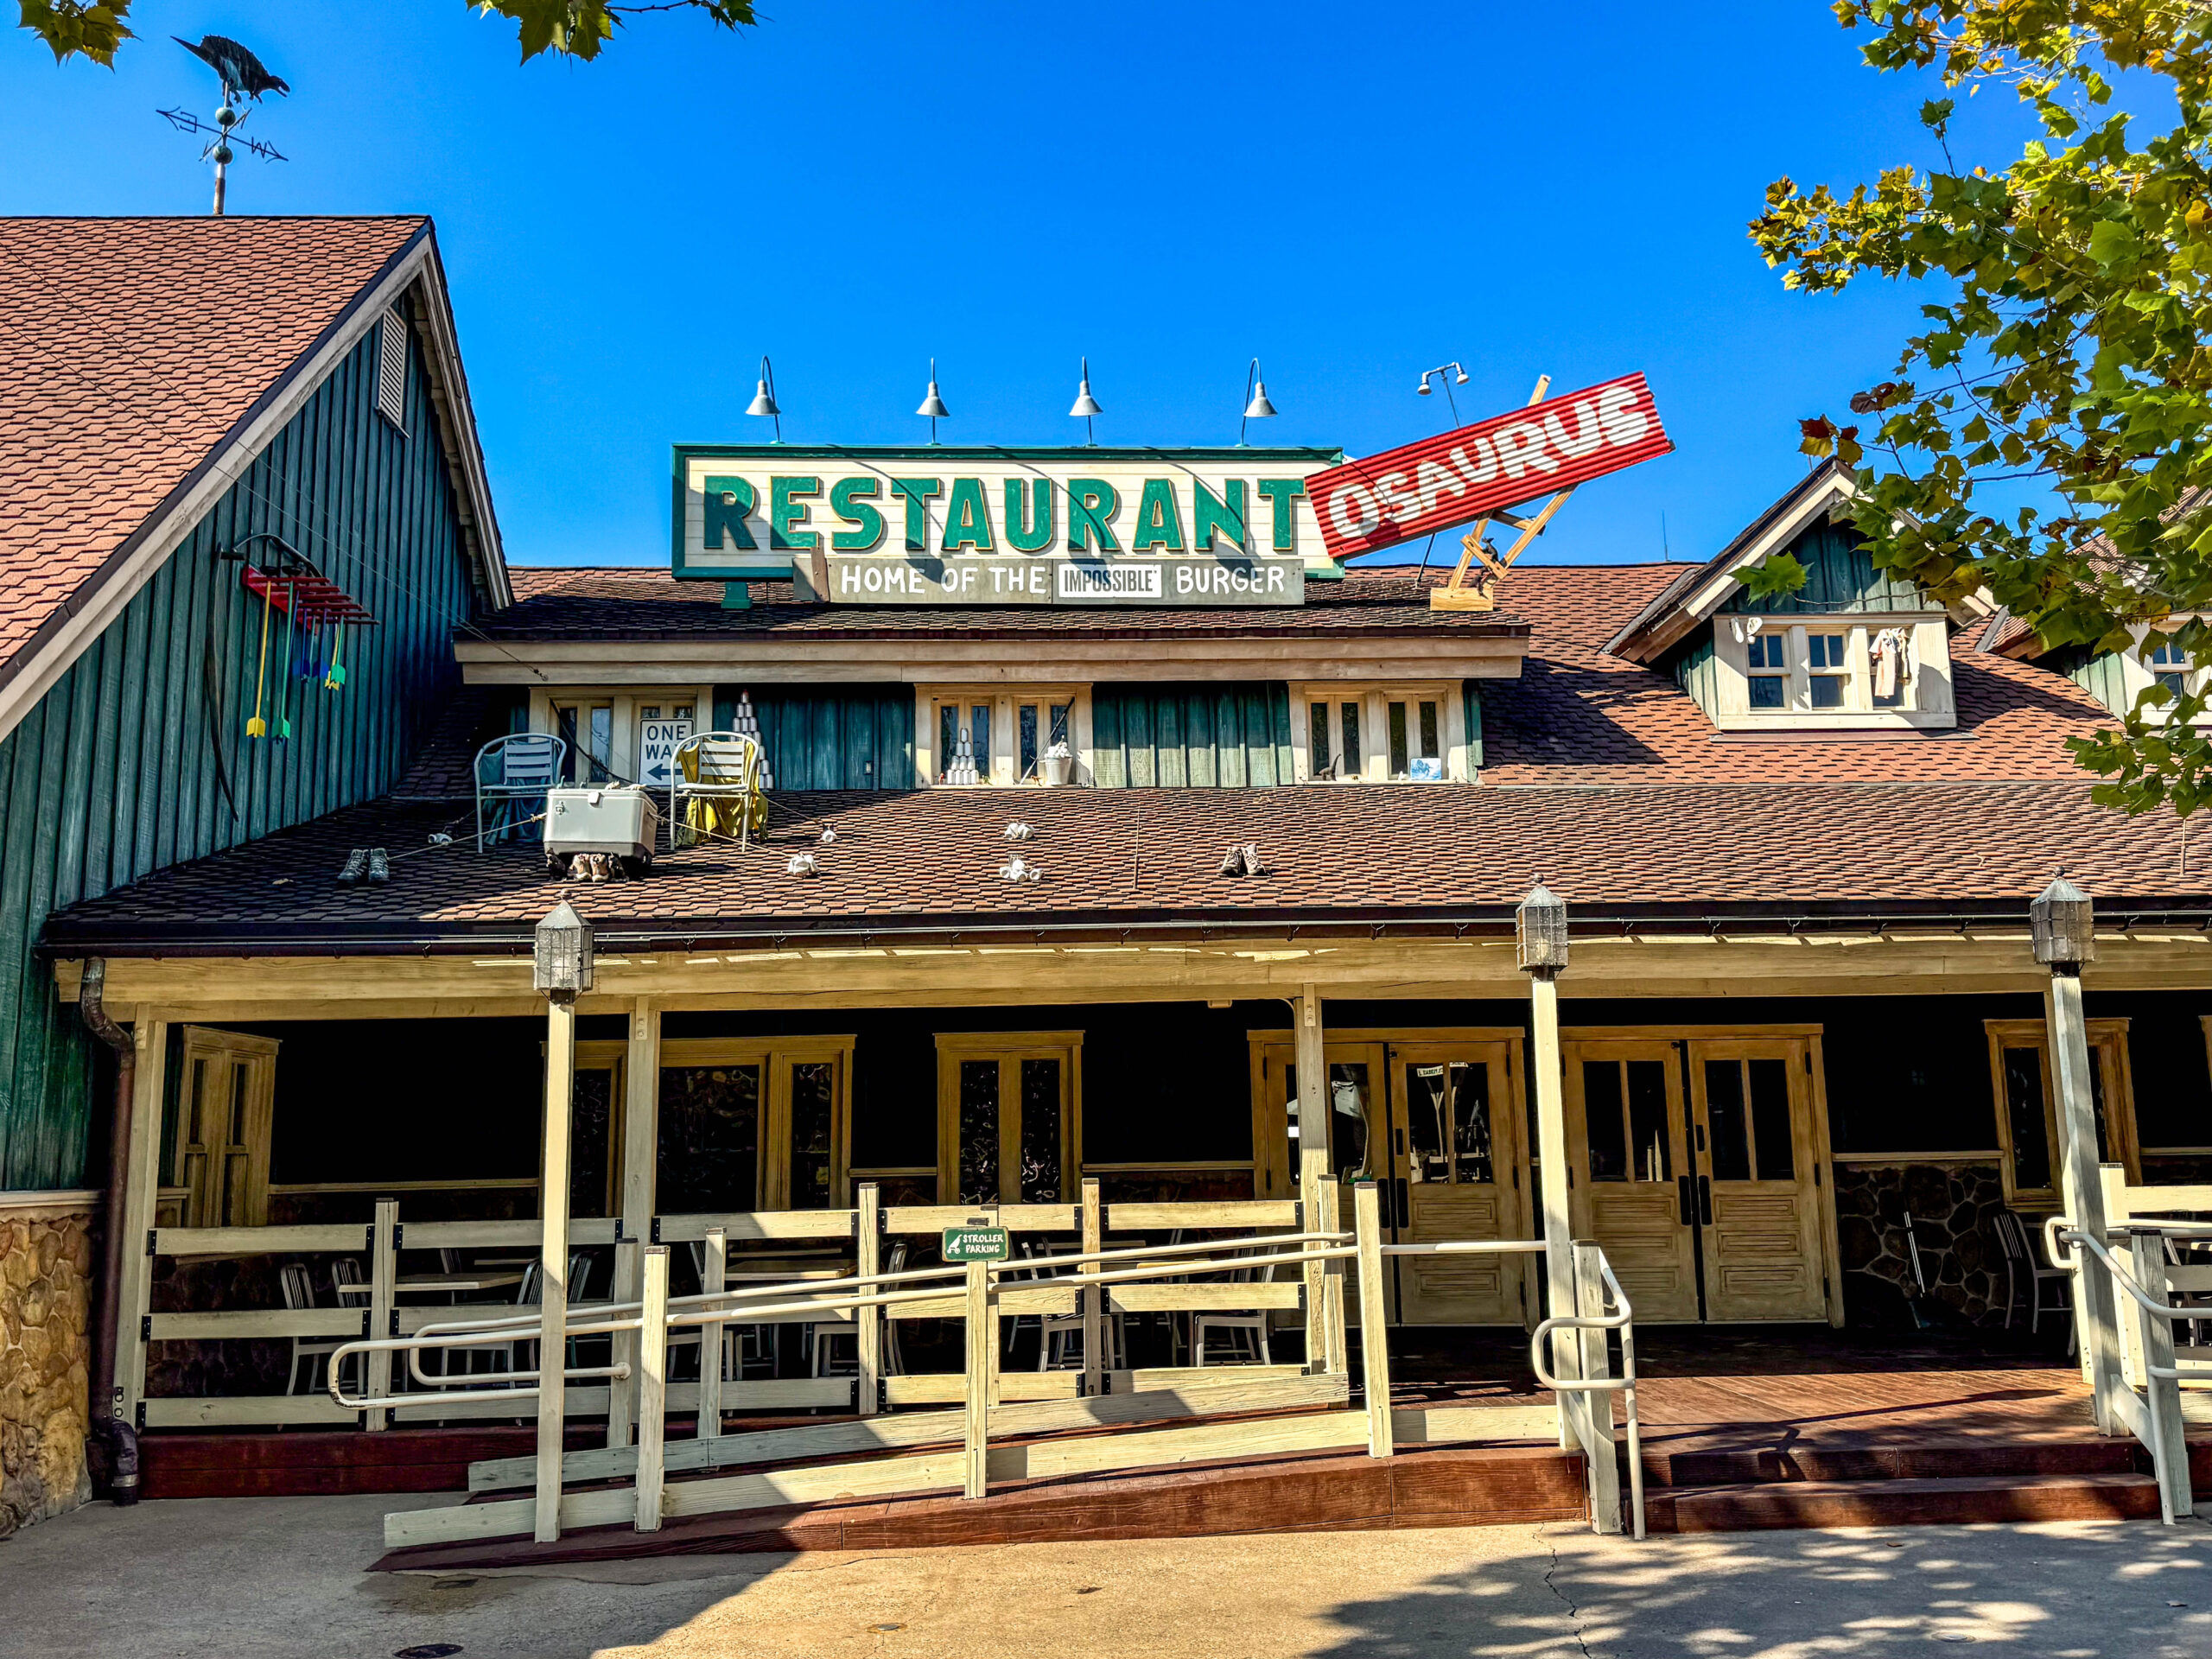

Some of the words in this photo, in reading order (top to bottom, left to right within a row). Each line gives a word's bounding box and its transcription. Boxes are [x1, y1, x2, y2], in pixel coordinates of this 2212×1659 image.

[1328, 385, 1650, 538] OSAURUS
[702, 474, 1306, 553] RESTAURANT
[841, 564, 925, 594] HOME
[940, 566, 978, 593] OF
[988, 566, 1046, 594] THE
[1064, 570, 1154, 592] IMPOSSIBLE
[1176, 566, 1285, 594] BURGER
[647, 725, 687, 741] ONE
[963, 1234, 1004, 1243] STROLLER
[965, 1244, 1001, 1253] PARKING
